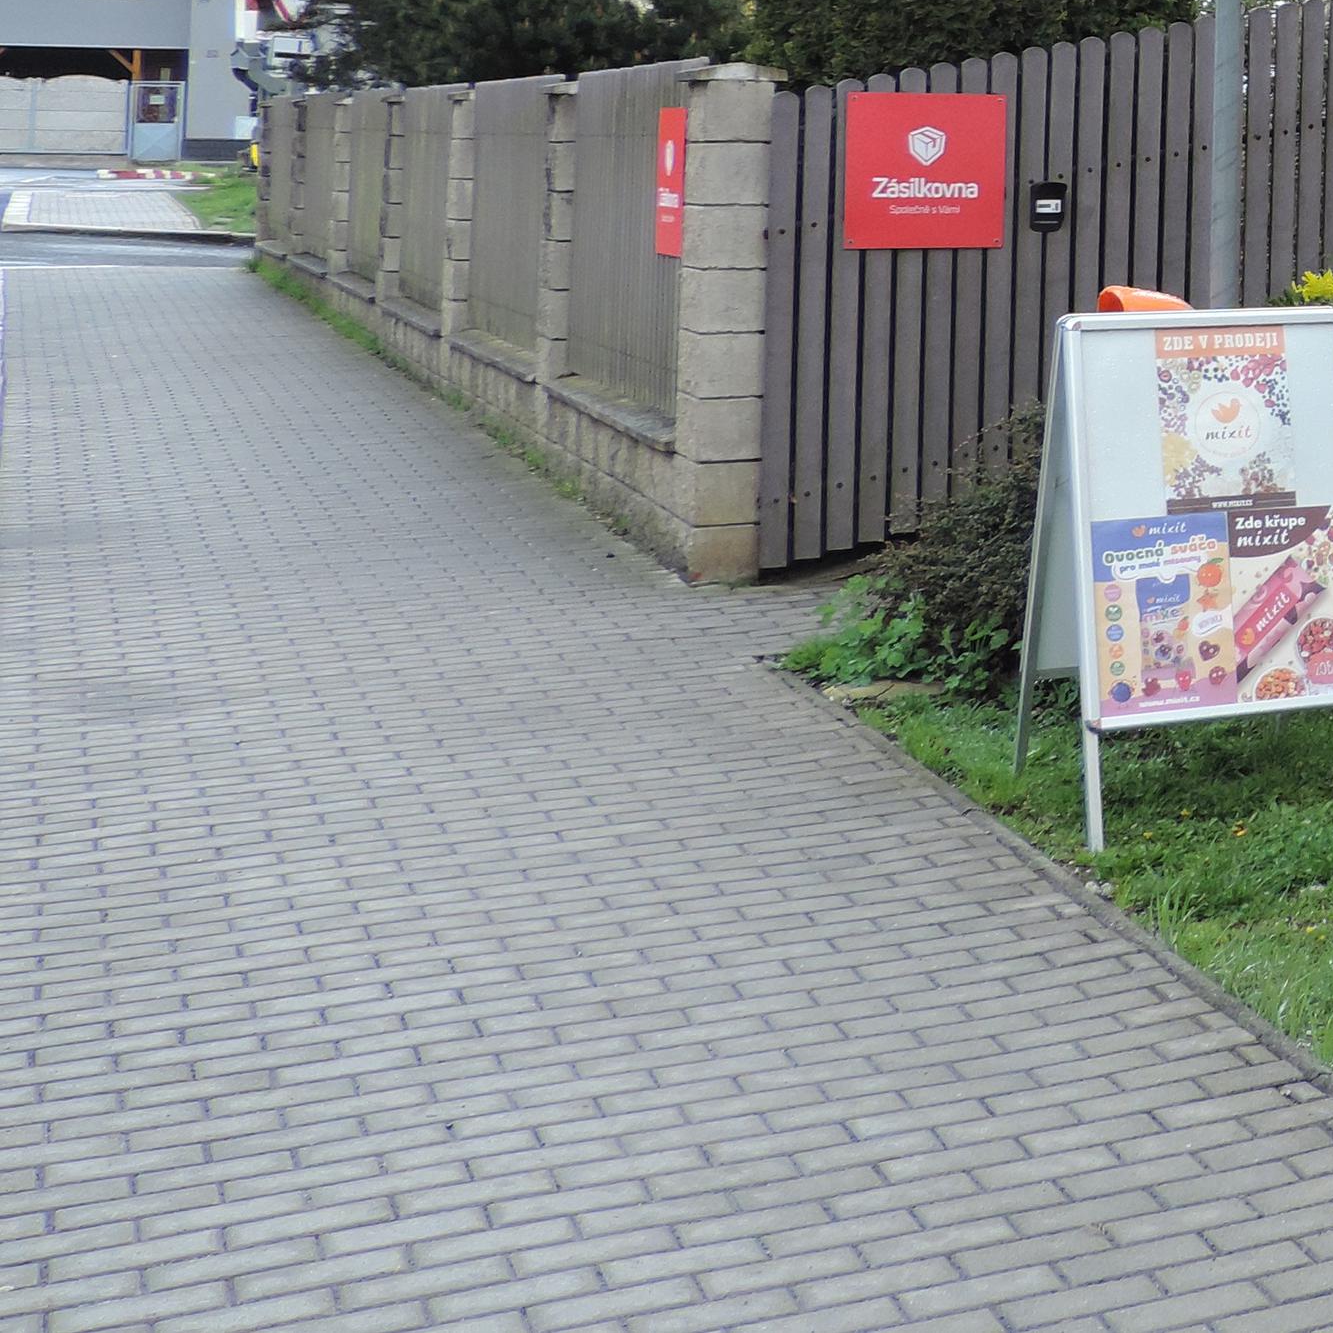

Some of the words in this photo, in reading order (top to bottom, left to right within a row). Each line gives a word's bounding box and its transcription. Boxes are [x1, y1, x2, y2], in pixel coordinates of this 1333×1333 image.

[872, 177, 979, 199] Zásilkovna
[1163, 335, 1194, 351] ZDE
[1198, 334, 1209, 349] V
[1214, 332, 1279, 349] PRODEJI
[1205, 425, 1252, 441] mixit
[1148, 522, 1188, 535] mixit
[1235, 516, 1263, 530] Zde
[1265, 514, 1306, 531] křupe
[1236, 529, 1290, 548] mixit
[1256, 591, 1291, 632] mixit
